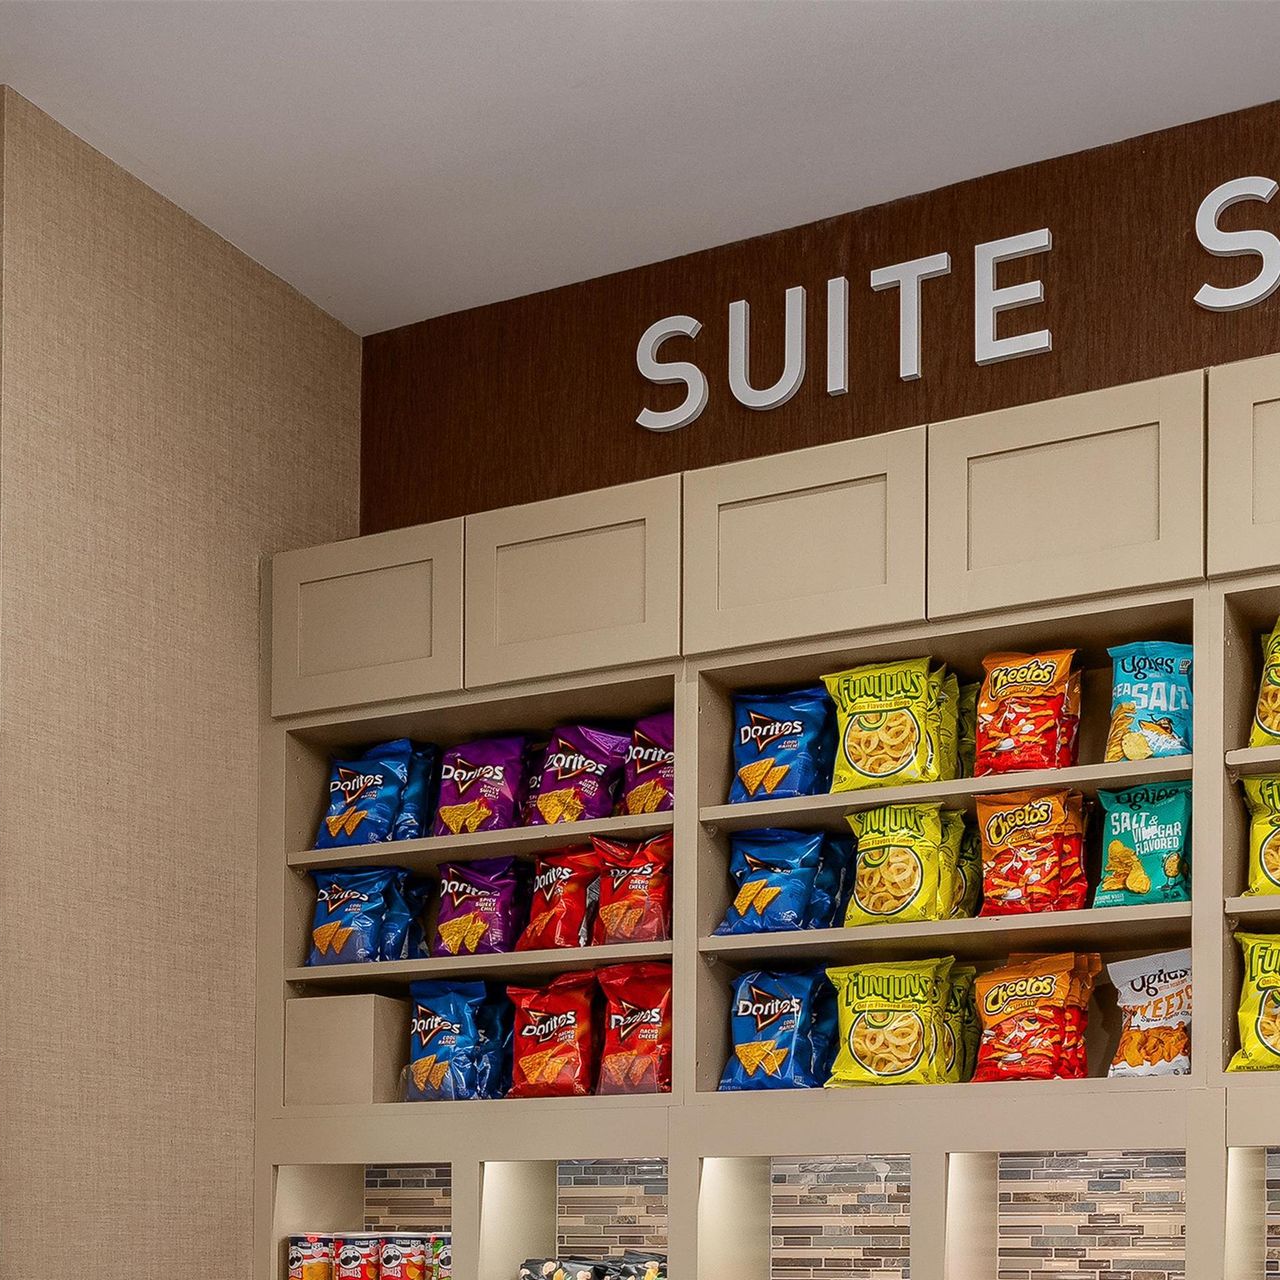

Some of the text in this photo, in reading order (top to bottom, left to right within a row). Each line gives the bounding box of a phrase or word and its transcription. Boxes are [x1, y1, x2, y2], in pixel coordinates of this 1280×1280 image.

[635, 227, 1052, 432] SUITE
[837, 673, 923, 700] FUNYUNS
[329, 773, 383, 794] Doritos
[441, 766, 504, 784] Doritos
[986, 802, 1053, 843] Cheetos
[1111, 813, 1147, 835] SALT
[1135, 837, 1179, 855] FLAVORED
[533, 866, 572, 891] Doritos
[984, 975, 1055, 1012] Cheetos
[737, 997, 801, 1018] Doritos
[411, 1015, 460, 1035] Doritos
[522, 1011, 575, 1038] Doritos
[339, 1268, 361, 1279] PRINGLES
